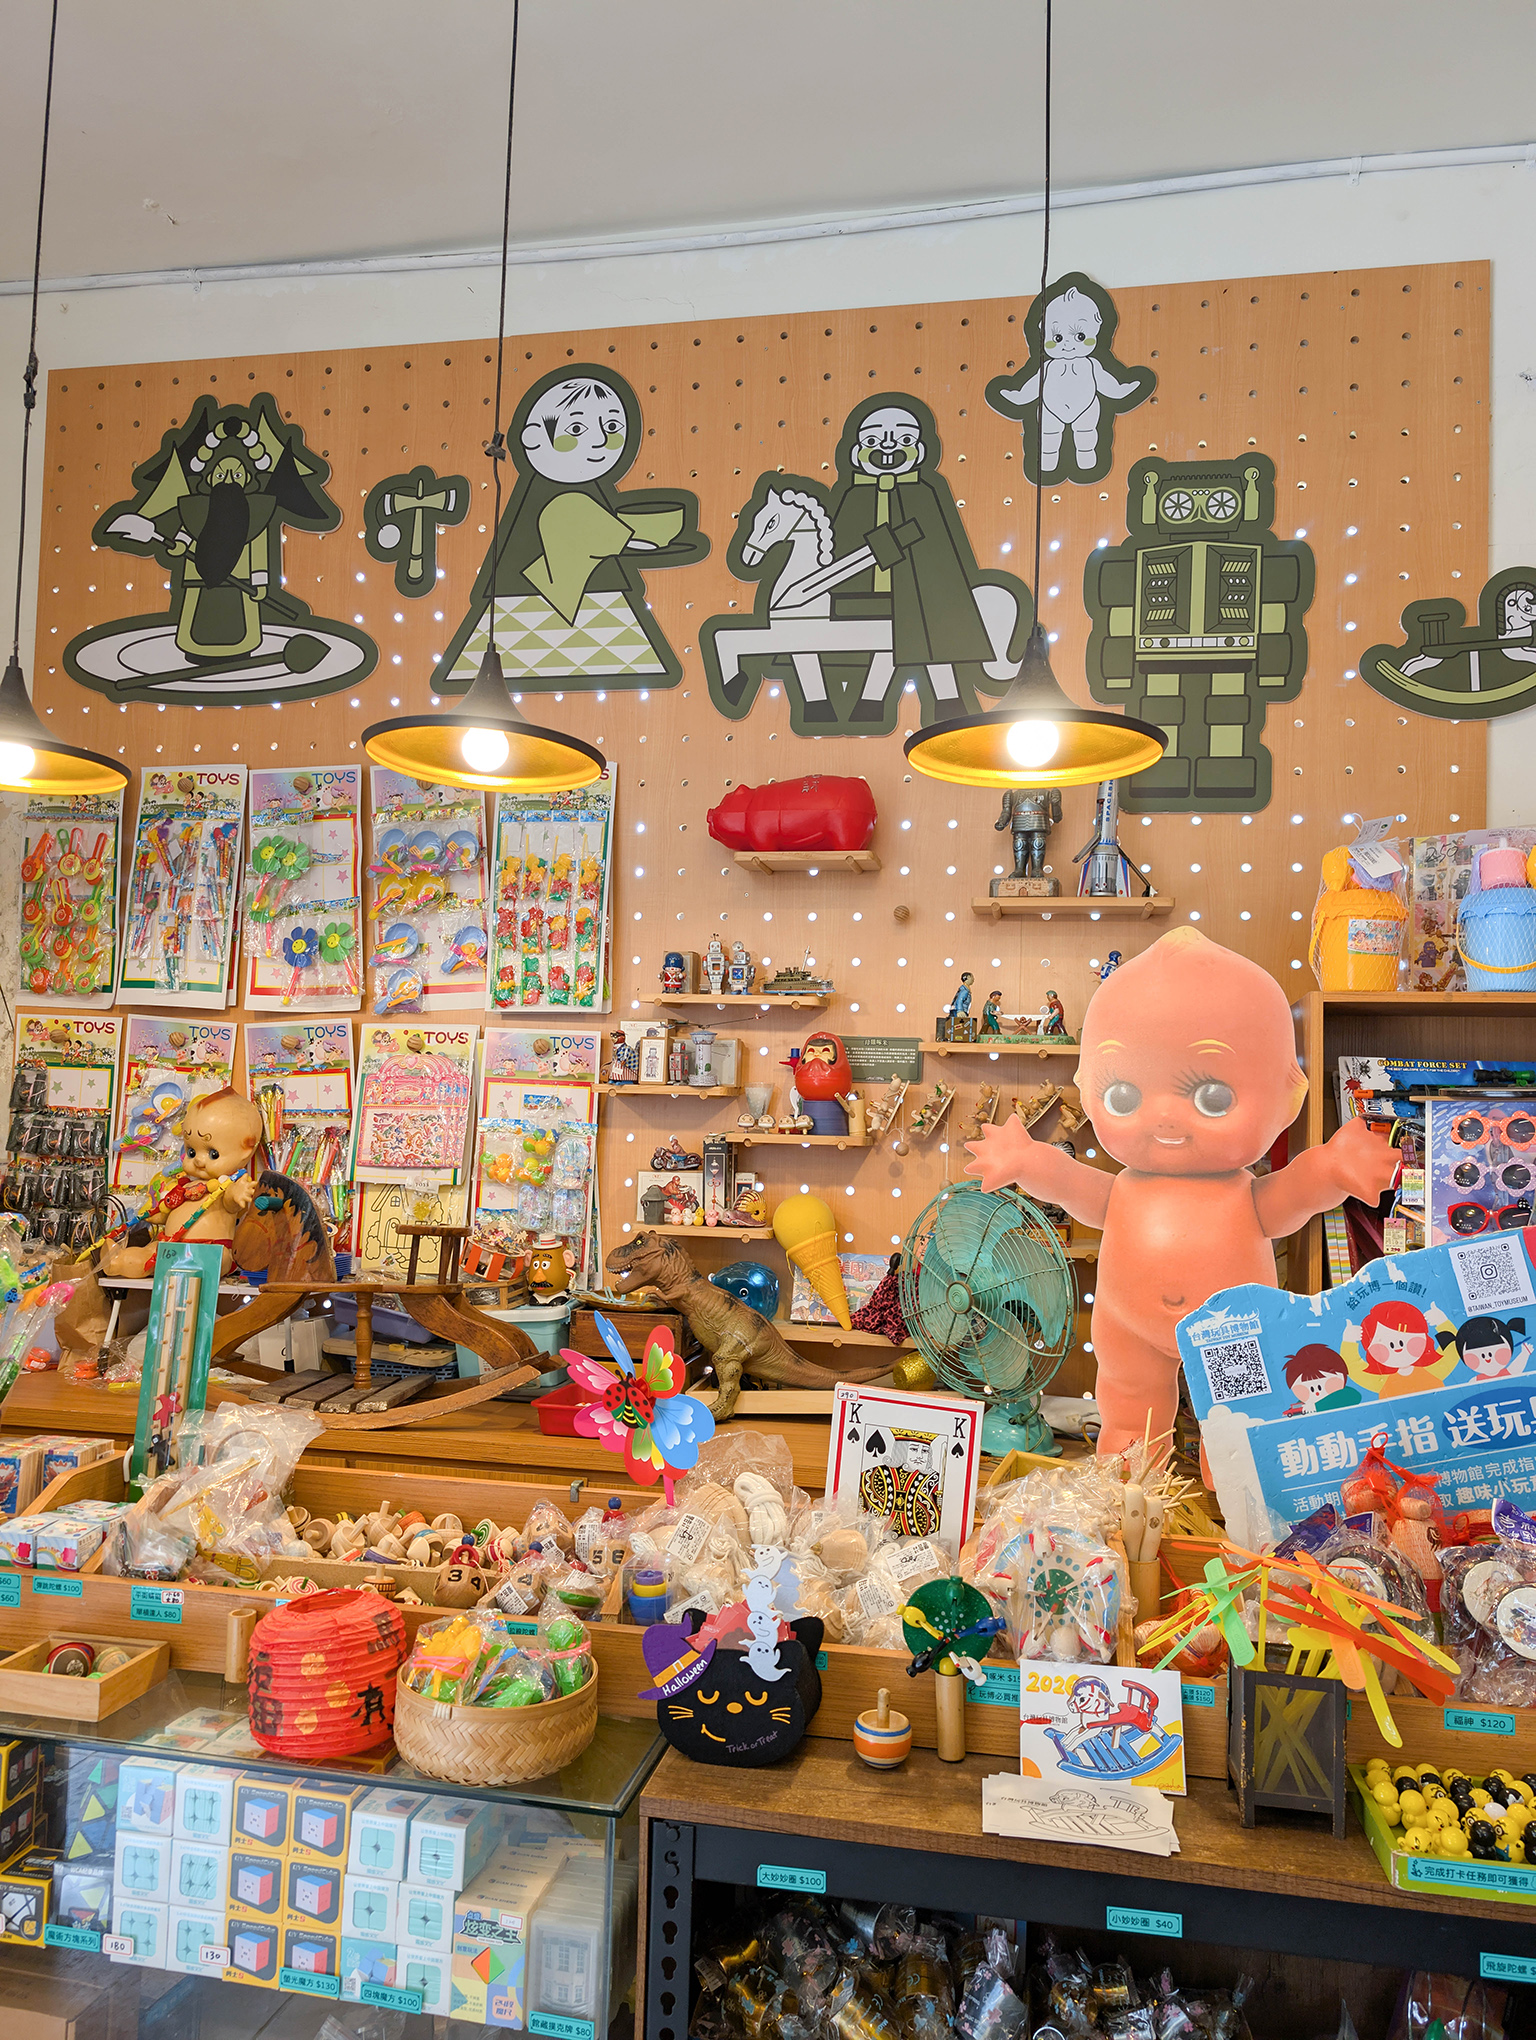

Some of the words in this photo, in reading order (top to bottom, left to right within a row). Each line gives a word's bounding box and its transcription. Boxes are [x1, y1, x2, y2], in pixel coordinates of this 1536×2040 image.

[196, 772, 240, 785] TOYS
[311, 771, 357, 785] TOYS
[73, 1021, 116, 1034] TOYS
[189, 1025, 231, 1041] TOYS
[303, 1025, 347, 1039] TOYS
[424, 1031, 469, 1045] TOYS
[550, 1036, 595, 1050] TOYS
[1377, 1059, 1415, 1068] COMBAT
[1417, 1061, 1448, 1069] FORCE
[1449, 1062, 1468, 1070] SET
[848, 1403, 863, 1424] K
[952, 1417, 967, 1439] K
[1443, 1398, 1536, 1449] 送玩
[448, 1569, 463, 1582] 3
[471, 1576, 482, 1591] 4
[63, 1584, 80, 1593] $100
[1, 1593, 15, 1602] $60
[163, 1610, 177, 1619] $80
[662, 1659, 708, 1696] Halloween
[1454, 1715, 1475, 1726] 福神
[1480, 1718, 1506, 1729] $120
[725, 1742, 749, 1753] Trick
[756, 1731, 778, 1746] Treat
[761, 1871, 797, 1884] 大妙妙圈
[799, 1876, 822, 1886] $100
[1424, 1866, 1529, 1888] 完成打卡任務即可獲得
[1111, 1914, 1150, 1928] 小妙妙圈
[1155, 1919, 1173, 1930] $40
[48, 1930, 97, 1948] 魔術方塊系列
[110, 1941, 126, 1951] 180
[204, 1950, 221, 1961] 130
[316, 1980, 336, 1991] $130
[363, 1989, 396, 2003] 四塊魔方
[398, 1995, 418, 2008] $100
[532, 2018, 575, 2034] 館藏撲克牌
[575, 2027, 591, 2038] $80
